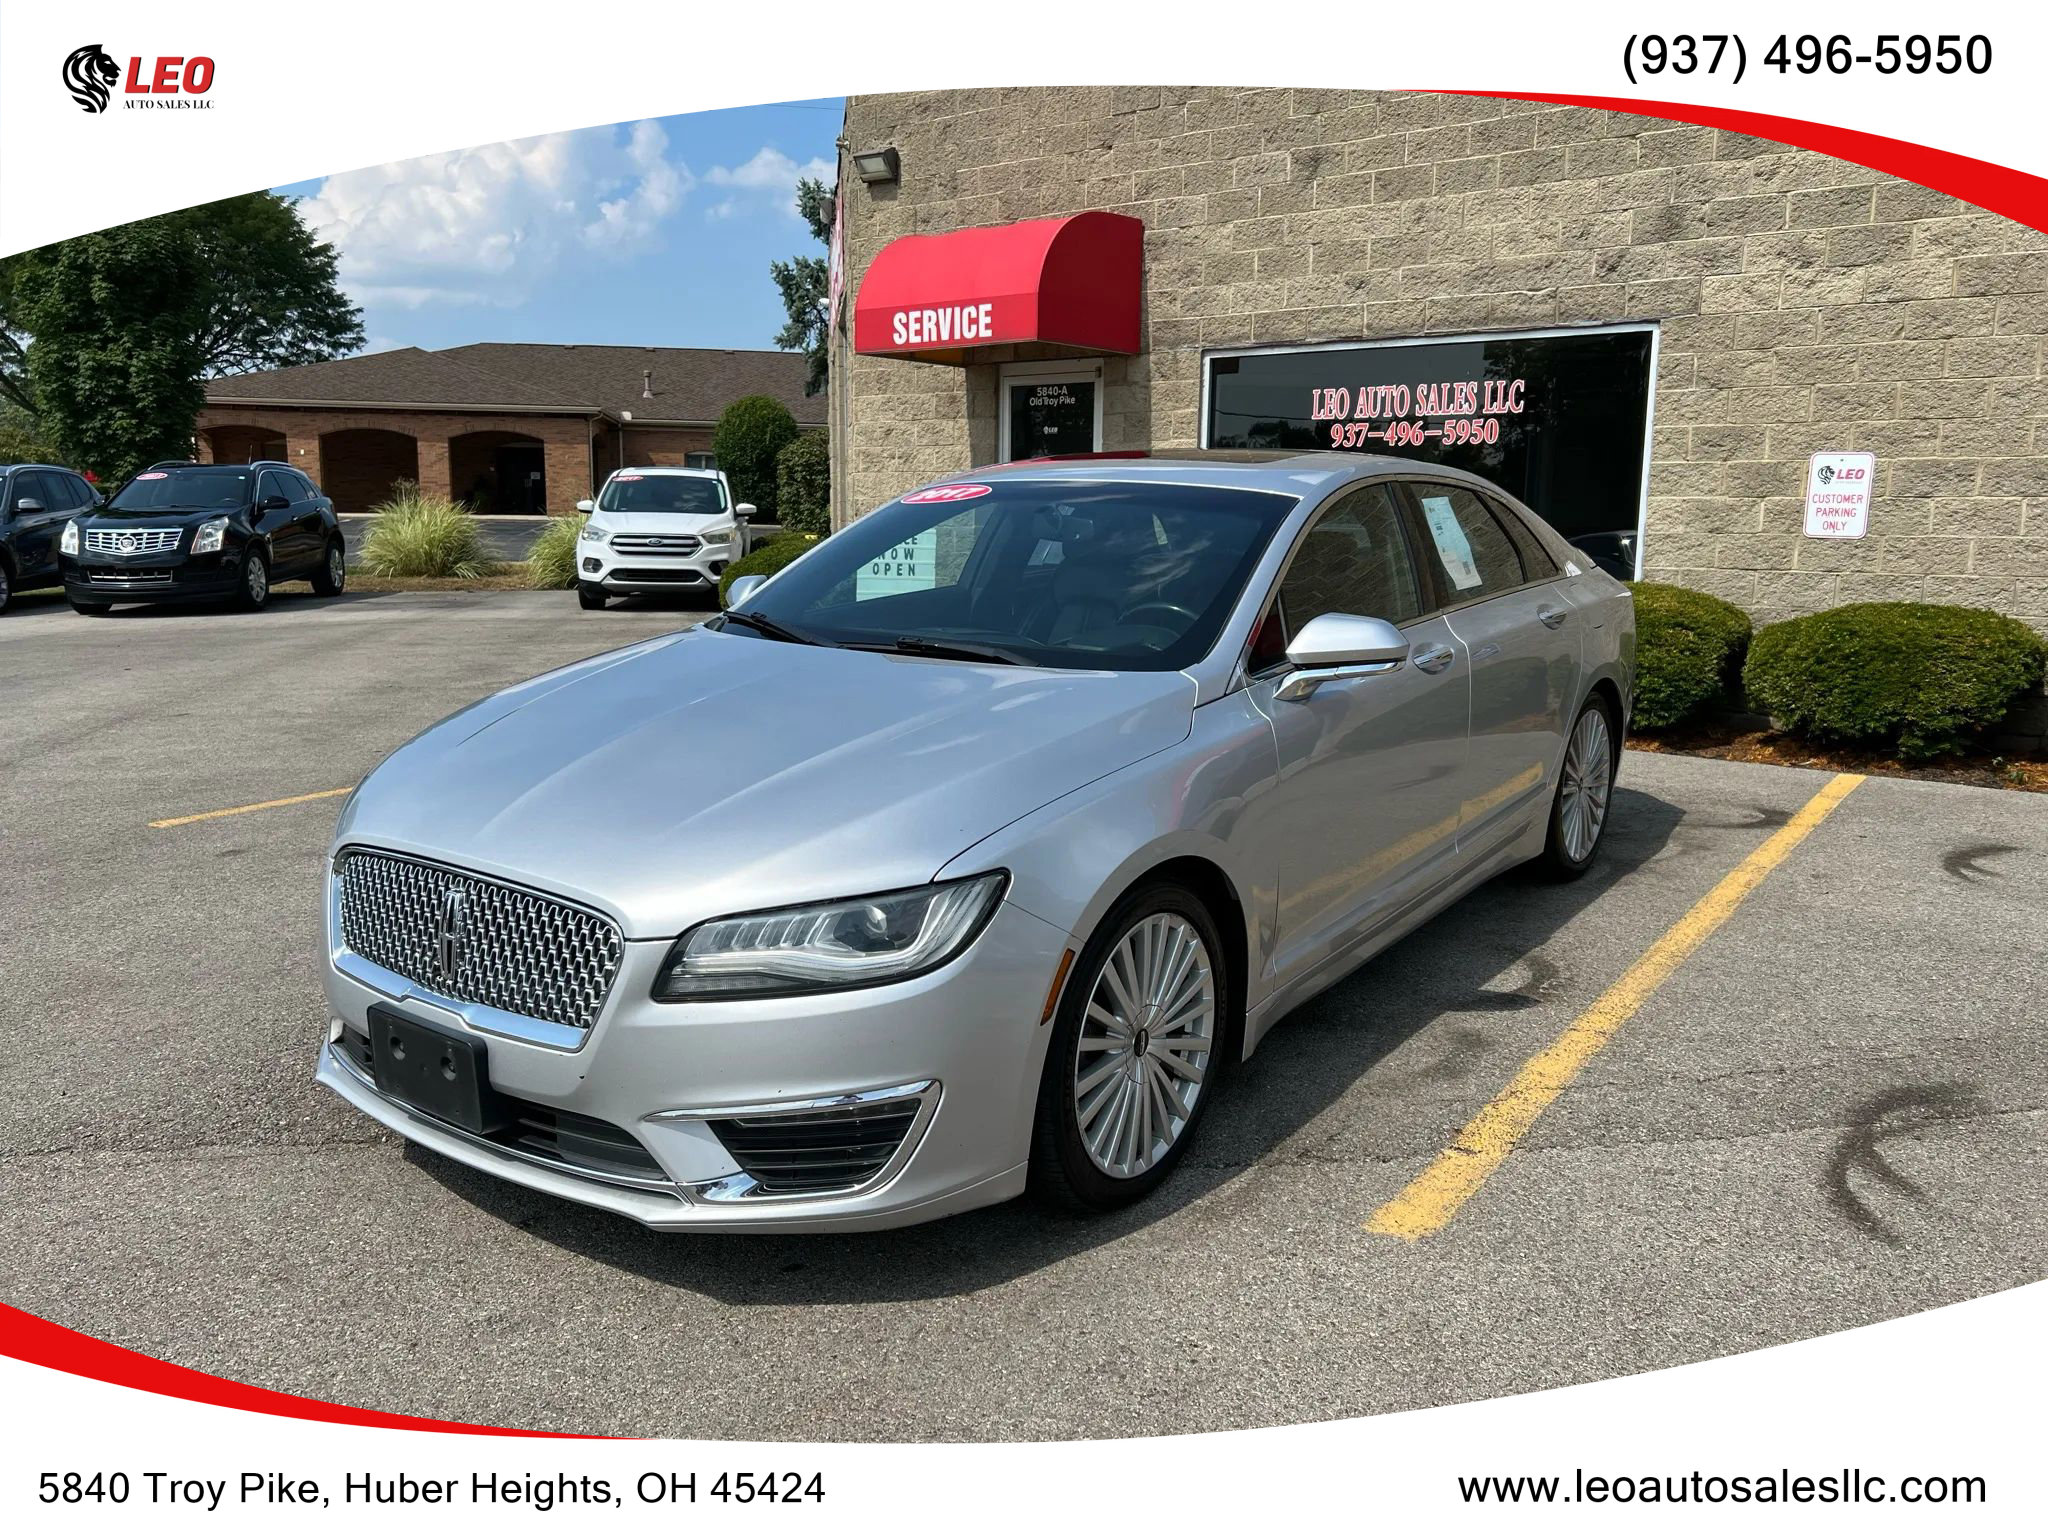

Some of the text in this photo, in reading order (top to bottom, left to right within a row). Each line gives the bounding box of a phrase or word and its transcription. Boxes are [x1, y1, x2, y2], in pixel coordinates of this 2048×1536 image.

[892, 303, 993, 345] SERVICE
[1036, 386, 1067, 396] 5840-A
[1029, 396, 1075, 407] Old Troy Pike
[1311, 378, 1526, 421] LEO AUTO SALES LLC
[1330, 417, 1500, 449] 937-496-5950
[1836, 468, 1865, 480] LEO
[1812, 494, 1864, 504] CUSTOMER
[1815, 507, 1857, 518] PARKING
[1822, 520, 1848, 531] ONLY
[872, 562, 916, 577] OPEN
